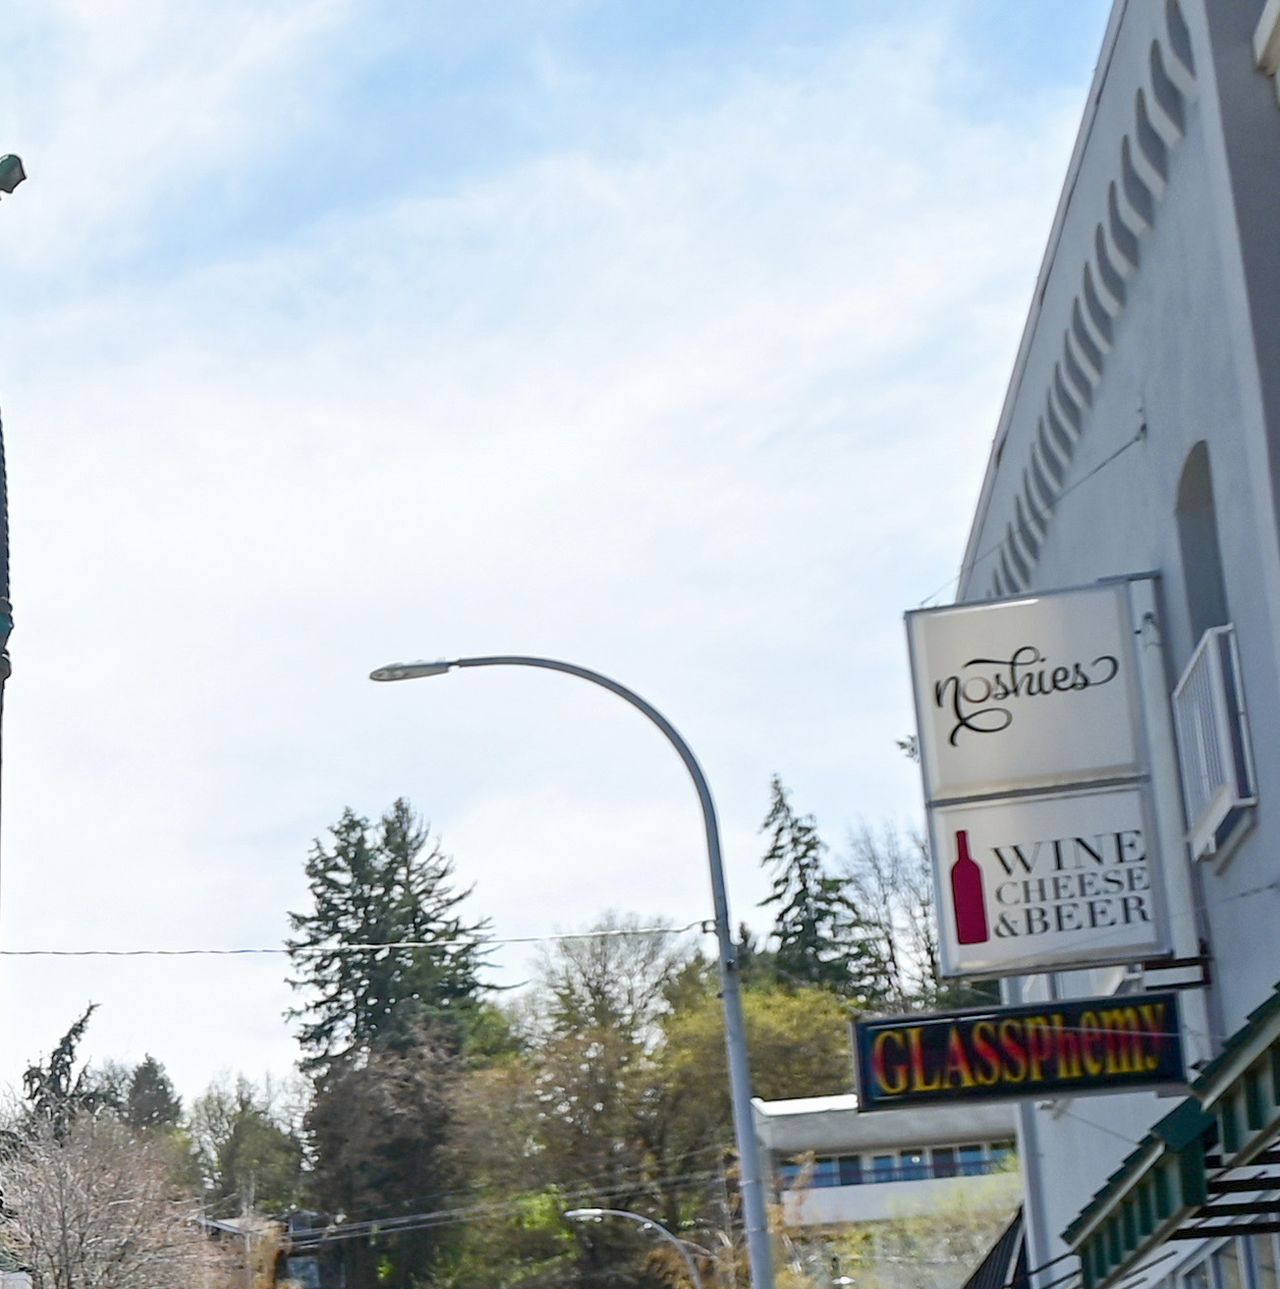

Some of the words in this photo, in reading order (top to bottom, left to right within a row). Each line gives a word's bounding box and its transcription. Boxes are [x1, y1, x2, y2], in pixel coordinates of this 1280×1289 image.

[934, 645, 1120, 748] noshies
[991, 828, 1147, 877] WINE
[994, 866, 1151, 907] CHEESE
